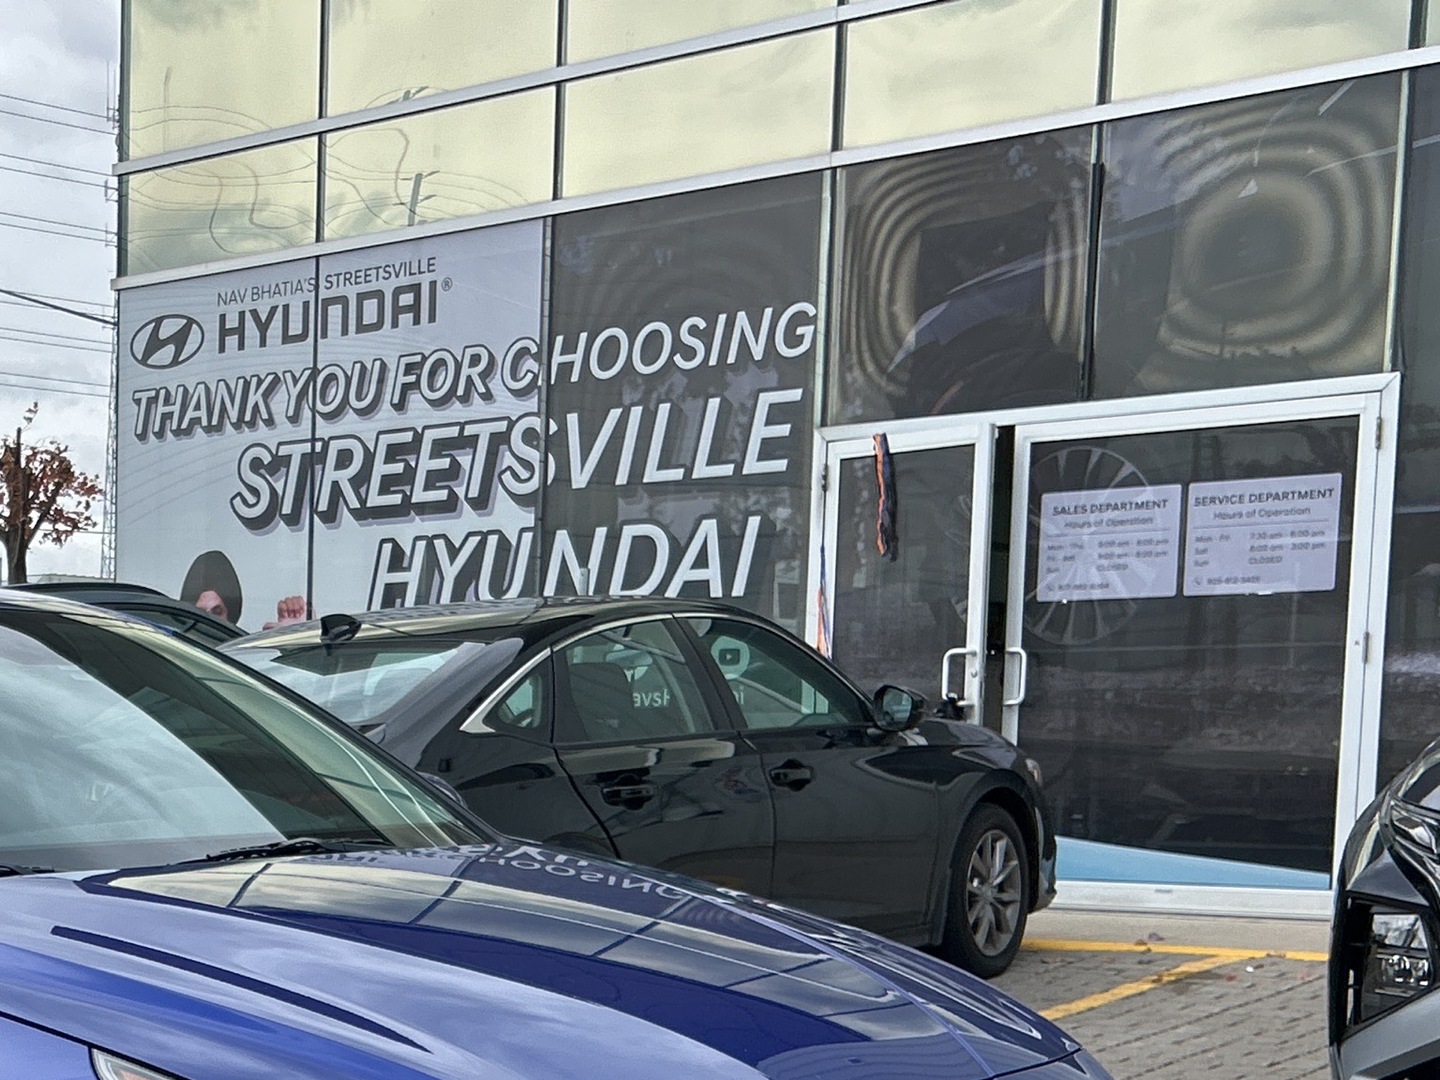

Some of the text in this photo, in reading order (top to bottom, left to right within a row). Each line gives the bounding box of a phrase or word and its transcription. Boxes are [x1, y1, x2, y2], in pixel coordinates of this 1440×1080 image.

[217, 256, 437, 307] NAV BHATIA'S STREETSVILLE
[217, 279, 438, 355] HYUNDAI
[132, 301, 817, 440] THANK YOU FOR CHOOSING
[230, 387, 803, 528] STREETSVILLE
[1052, 499, 1169, 517] SALES DEPARTMENT
[1193, 488, 1335, 507] SERVICE DEPARTMENT
[1213, 507, 1312, 520] Hours of Operation
[370, 514, 762, 612] HYUNDAI
